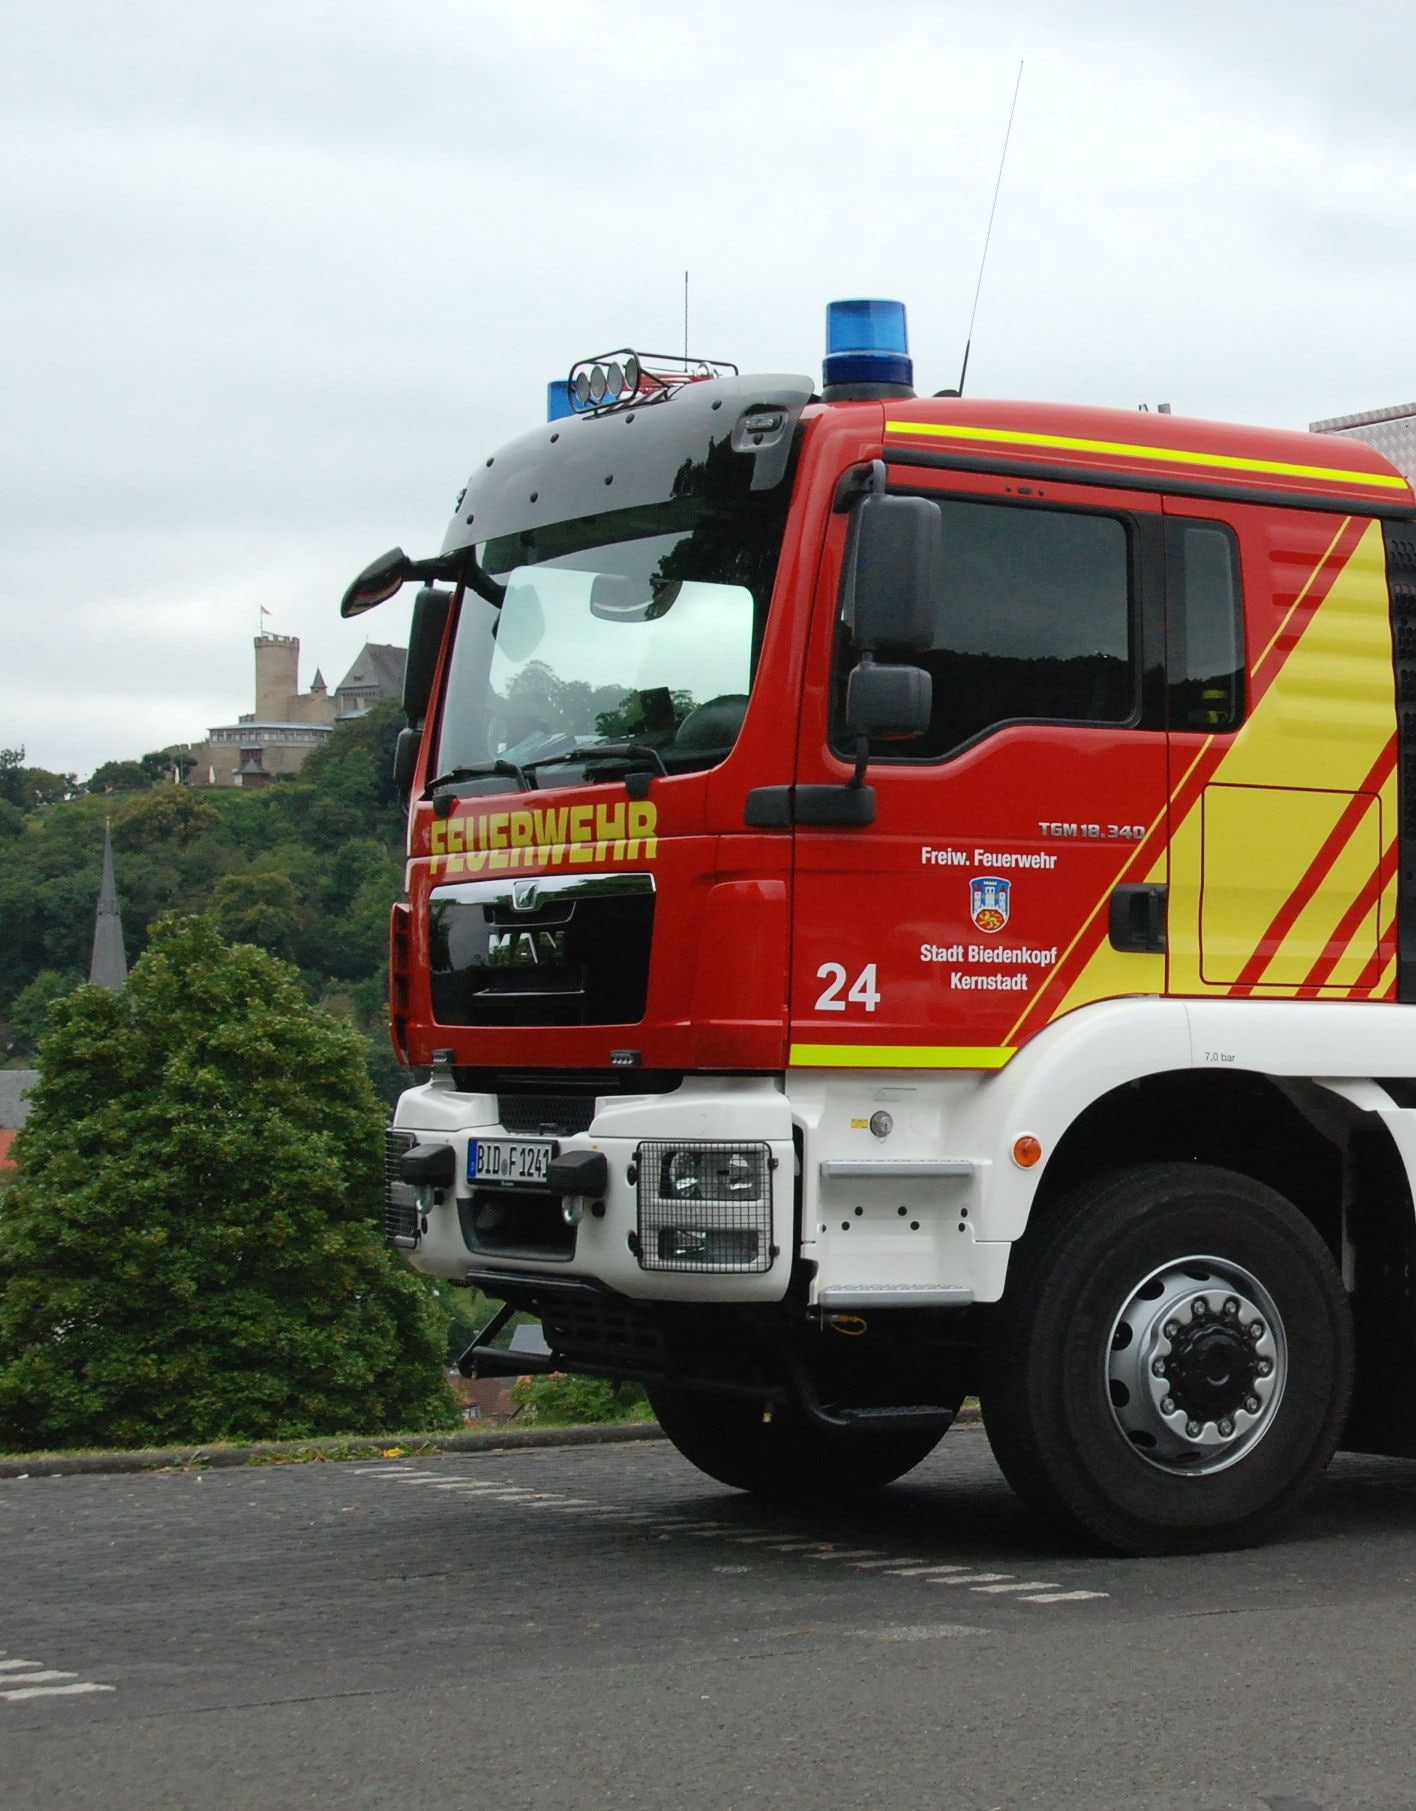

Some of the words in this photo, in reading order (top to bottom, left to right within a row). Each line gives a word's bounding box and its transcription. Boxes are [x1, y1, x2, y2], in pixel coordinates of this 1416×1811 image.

[429, 800, 658, 875] FEUERWEHR
[1038, 821, 1078, 838] TGM
[1080, 823, 1146, 840] 18.340
[921, 847, 970, 866] Freiw.
[974, 848, 1057, 869] Feuerwehr
[920, 943, 964, 963] Stadt
[968, 945, 1057, 968] Biedenkopf
[814, 962, 881, 1012] 24
[951, 972, 1028, 991] Kernstadt
[1220, 1051, 1236, 1062] bar
[477, 1144, 501, 1175] BID
[508, 1146, 517, 1176] F
[519, 1147, 550, 1178] 1241
